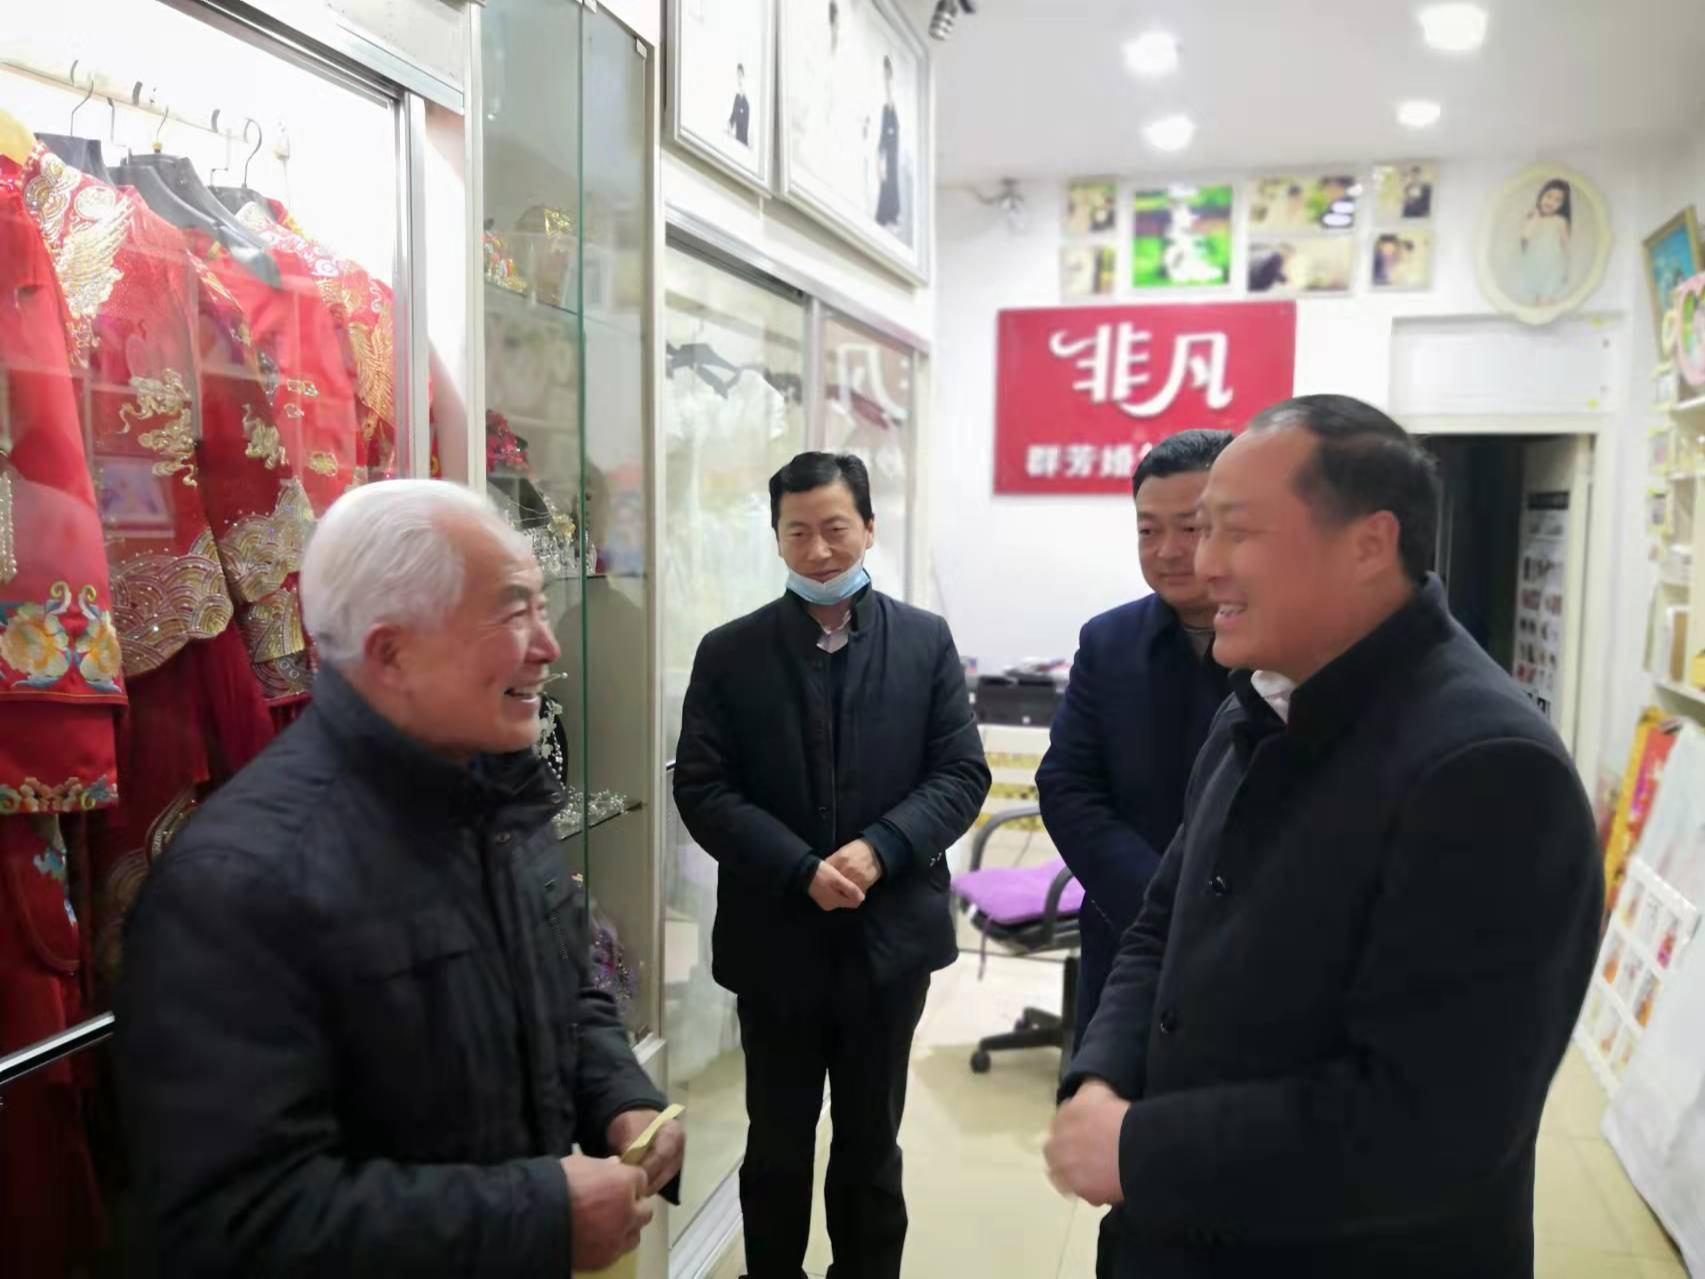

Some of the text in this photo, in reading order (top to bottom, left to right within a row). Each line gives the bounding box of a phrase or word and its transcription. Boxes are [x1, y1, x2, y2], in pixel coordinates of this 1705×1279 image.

[1050, 322, 1233, 416] 非凡
[1025, 442, 1152, 478] 群芳婚
